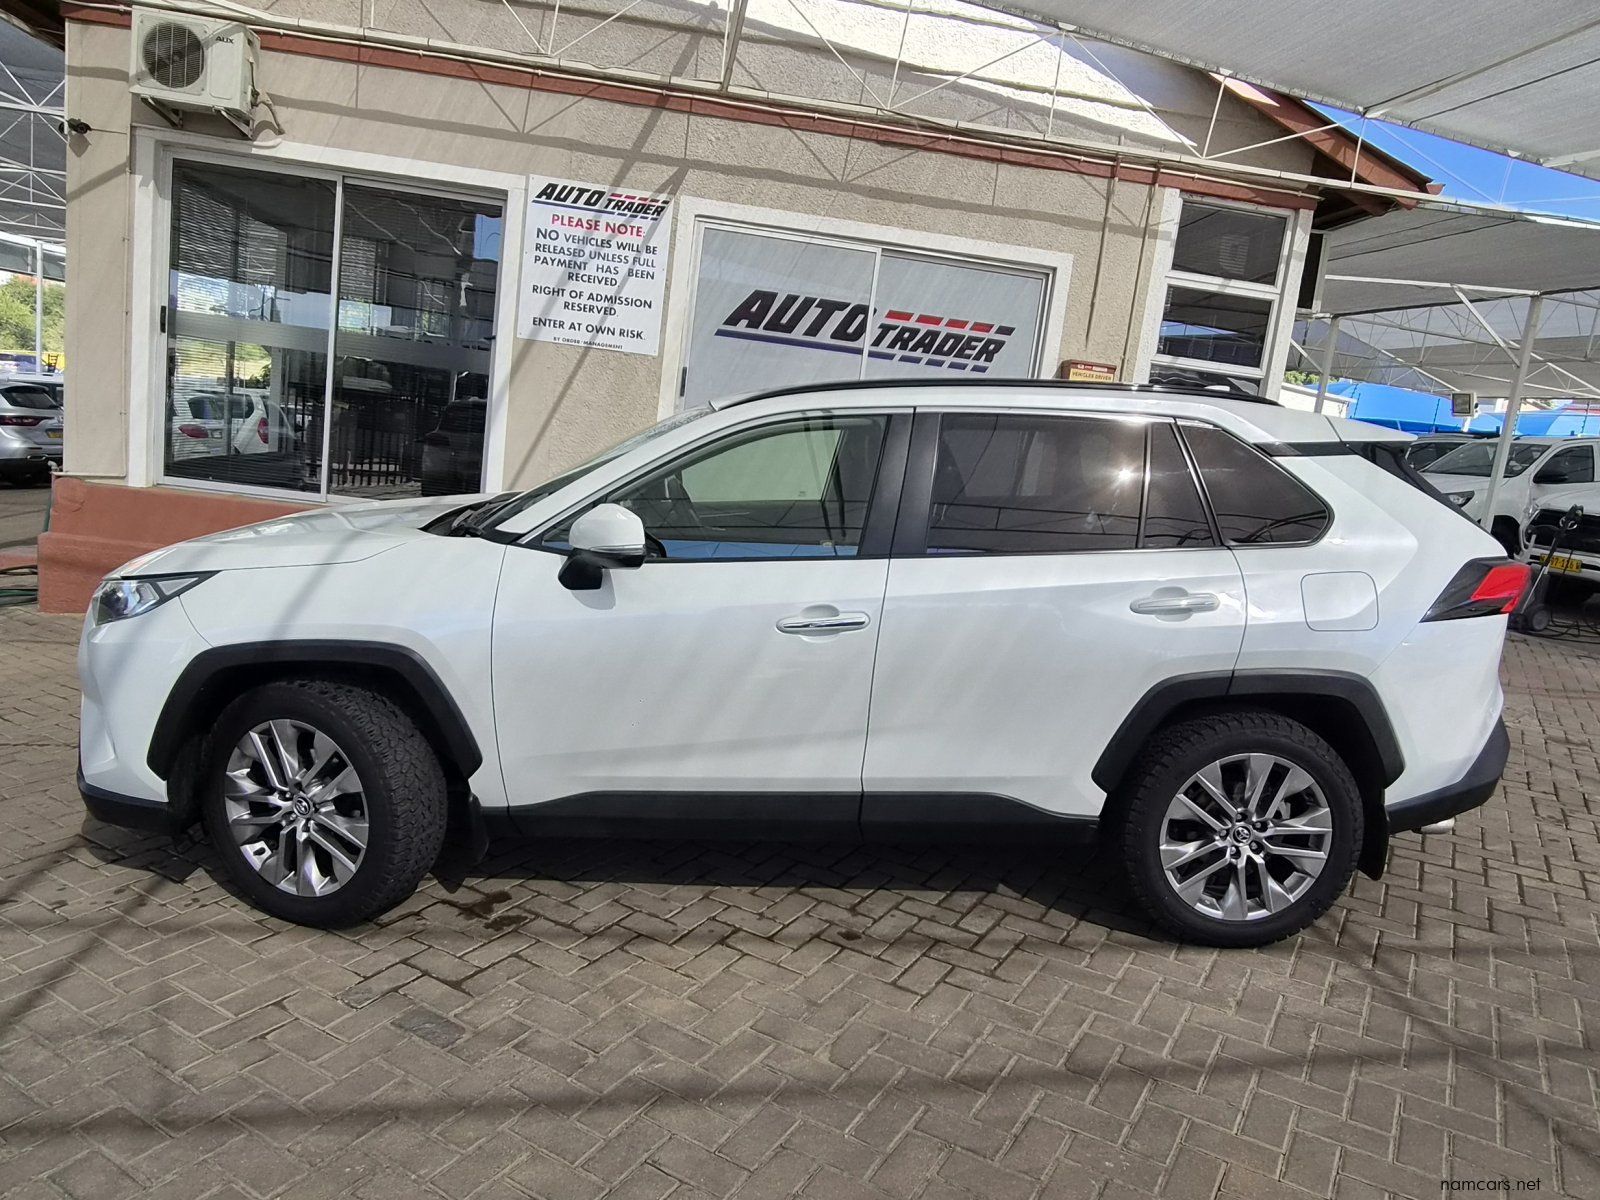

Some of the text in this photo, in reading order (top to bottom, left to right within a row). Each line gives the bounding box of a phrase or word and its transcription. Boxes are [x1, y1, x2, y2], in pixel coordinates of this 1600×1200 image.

[215, 36, 234, 44] AUX
[535, 182, 667, 216] AUTO TRADER
[551, 213, 645, 238] PLEASE NOTE:
[536, 227, 658, 255] NO VEHICLES WILL BE
[534, 255, 655, 280] PAYMENT HAS BEEN
[535, 242, 656, 268] RELEASED UNLESS FULL
[567, 271, 621, 288] RECEIVED.
[532, 284, 652, 309] RIGHT OF ADMISSION
[532, 316, 565, 330] ENTER
[568, 321, 582, 332] AT
[585, 323, 616, 336] OWN
[722, 289, 1006, 363] AUTO TRADER
